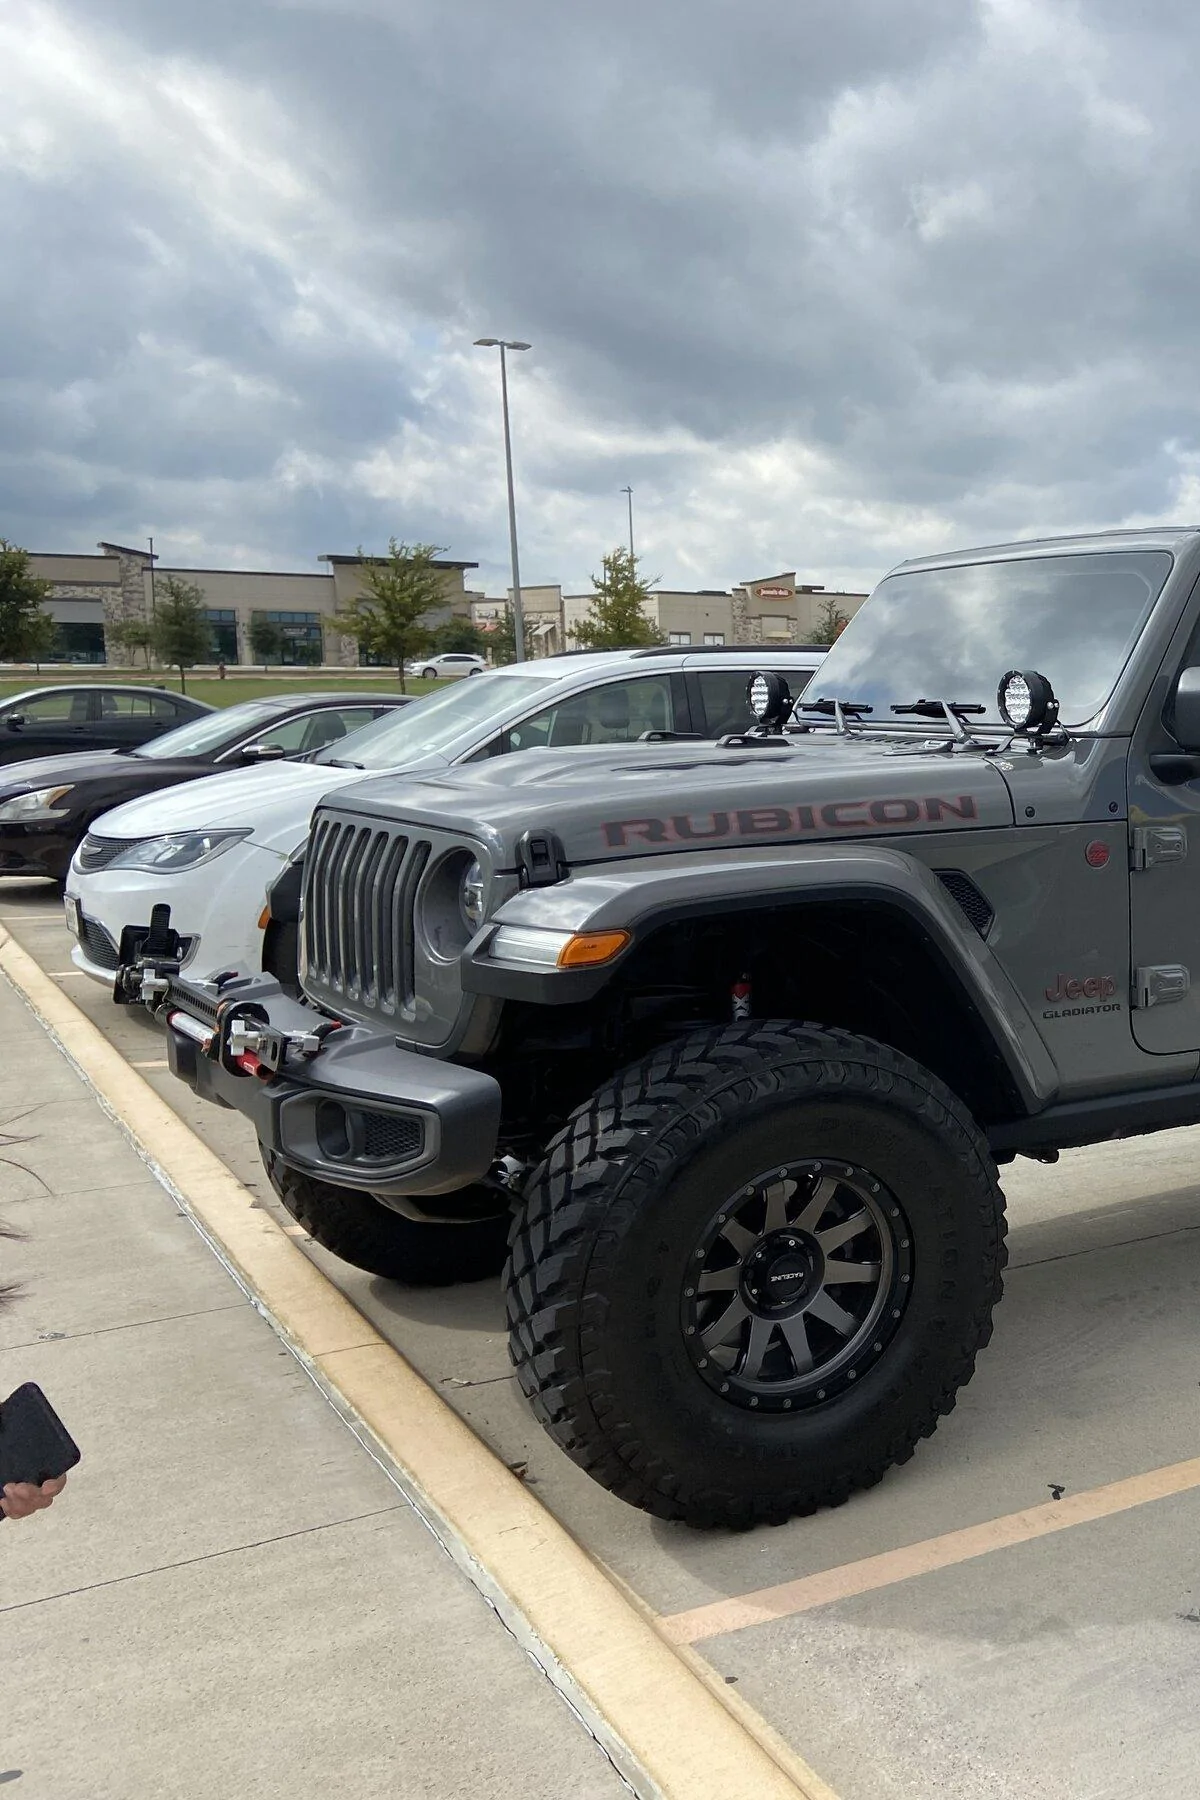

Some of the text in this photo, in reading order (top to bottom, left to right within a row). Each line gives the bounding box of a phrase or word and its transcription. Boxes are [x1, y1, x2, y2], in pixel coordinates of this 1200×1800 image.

[601, 794, 979, 849] RUBICON
[1044, 972, 1118, 1002] Jeep
[1042, 1003, 1121, 1019] GLADIATOR
[770, 1271, 804, 1282] RACELINE
